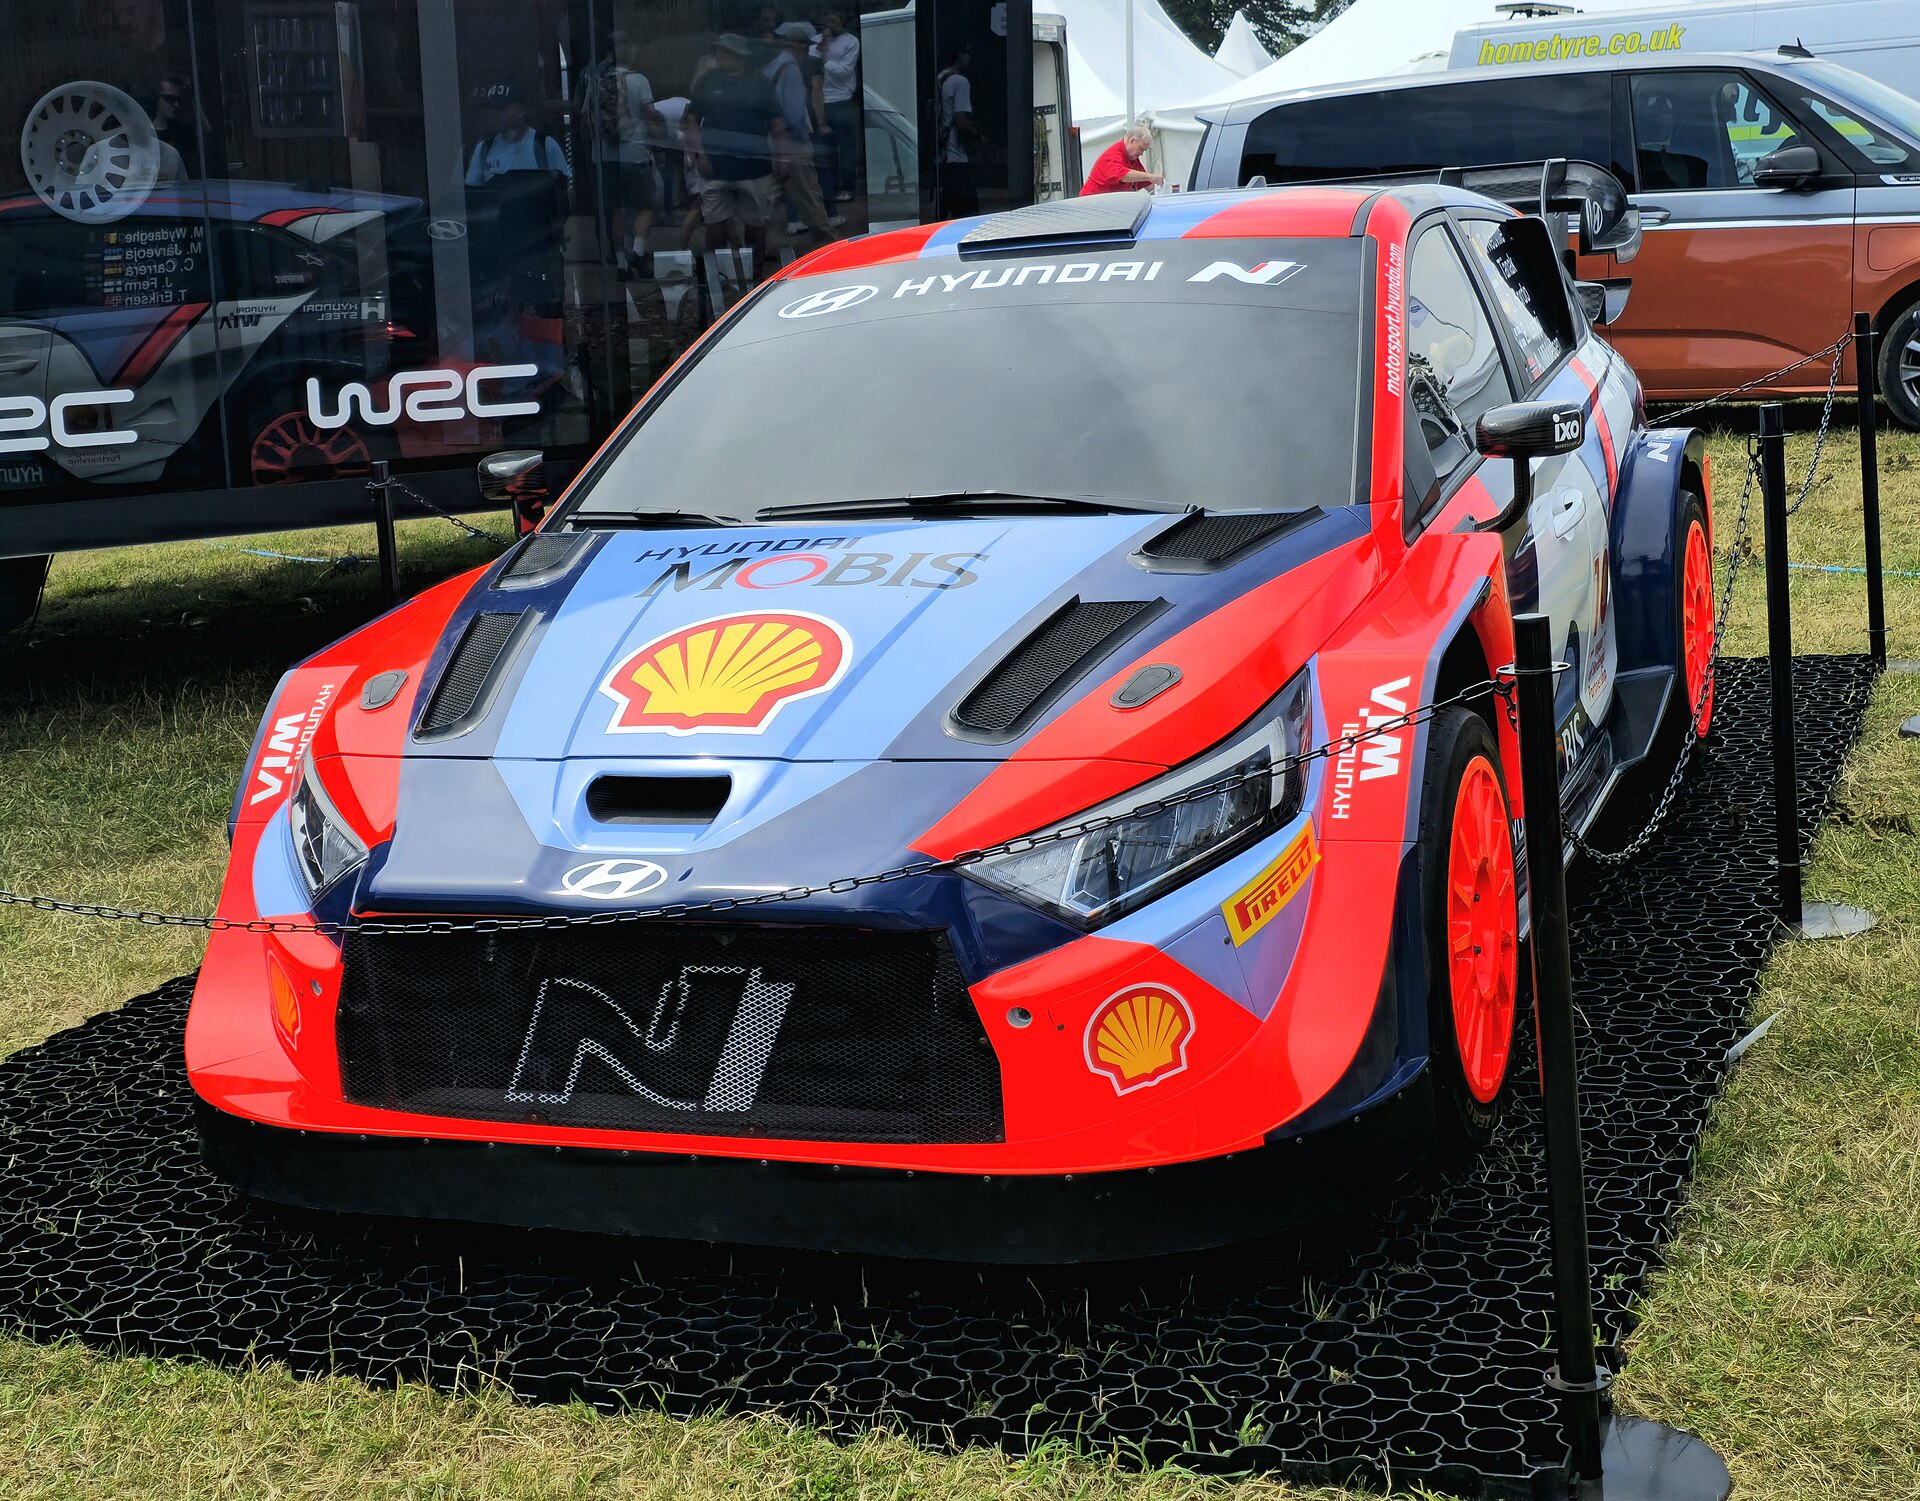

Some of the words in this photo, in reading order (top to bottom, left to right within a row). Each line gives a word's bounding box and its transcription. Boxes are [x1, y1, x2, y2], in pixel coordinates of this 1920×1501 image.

[1477, 22, 1686, 66] hometyre.co.uk
[890, 260, 1164, 300] HYUNDAI
[1384, 242, 1402, 397] motorsport.hyundai.com
[306, 363, 541, 429] WRC
[633, 535, 863, 564] HYUNDAI
[633, 551, 990, 599] MOBIS
[1233, 834, 1312, 933] PIRELLI
